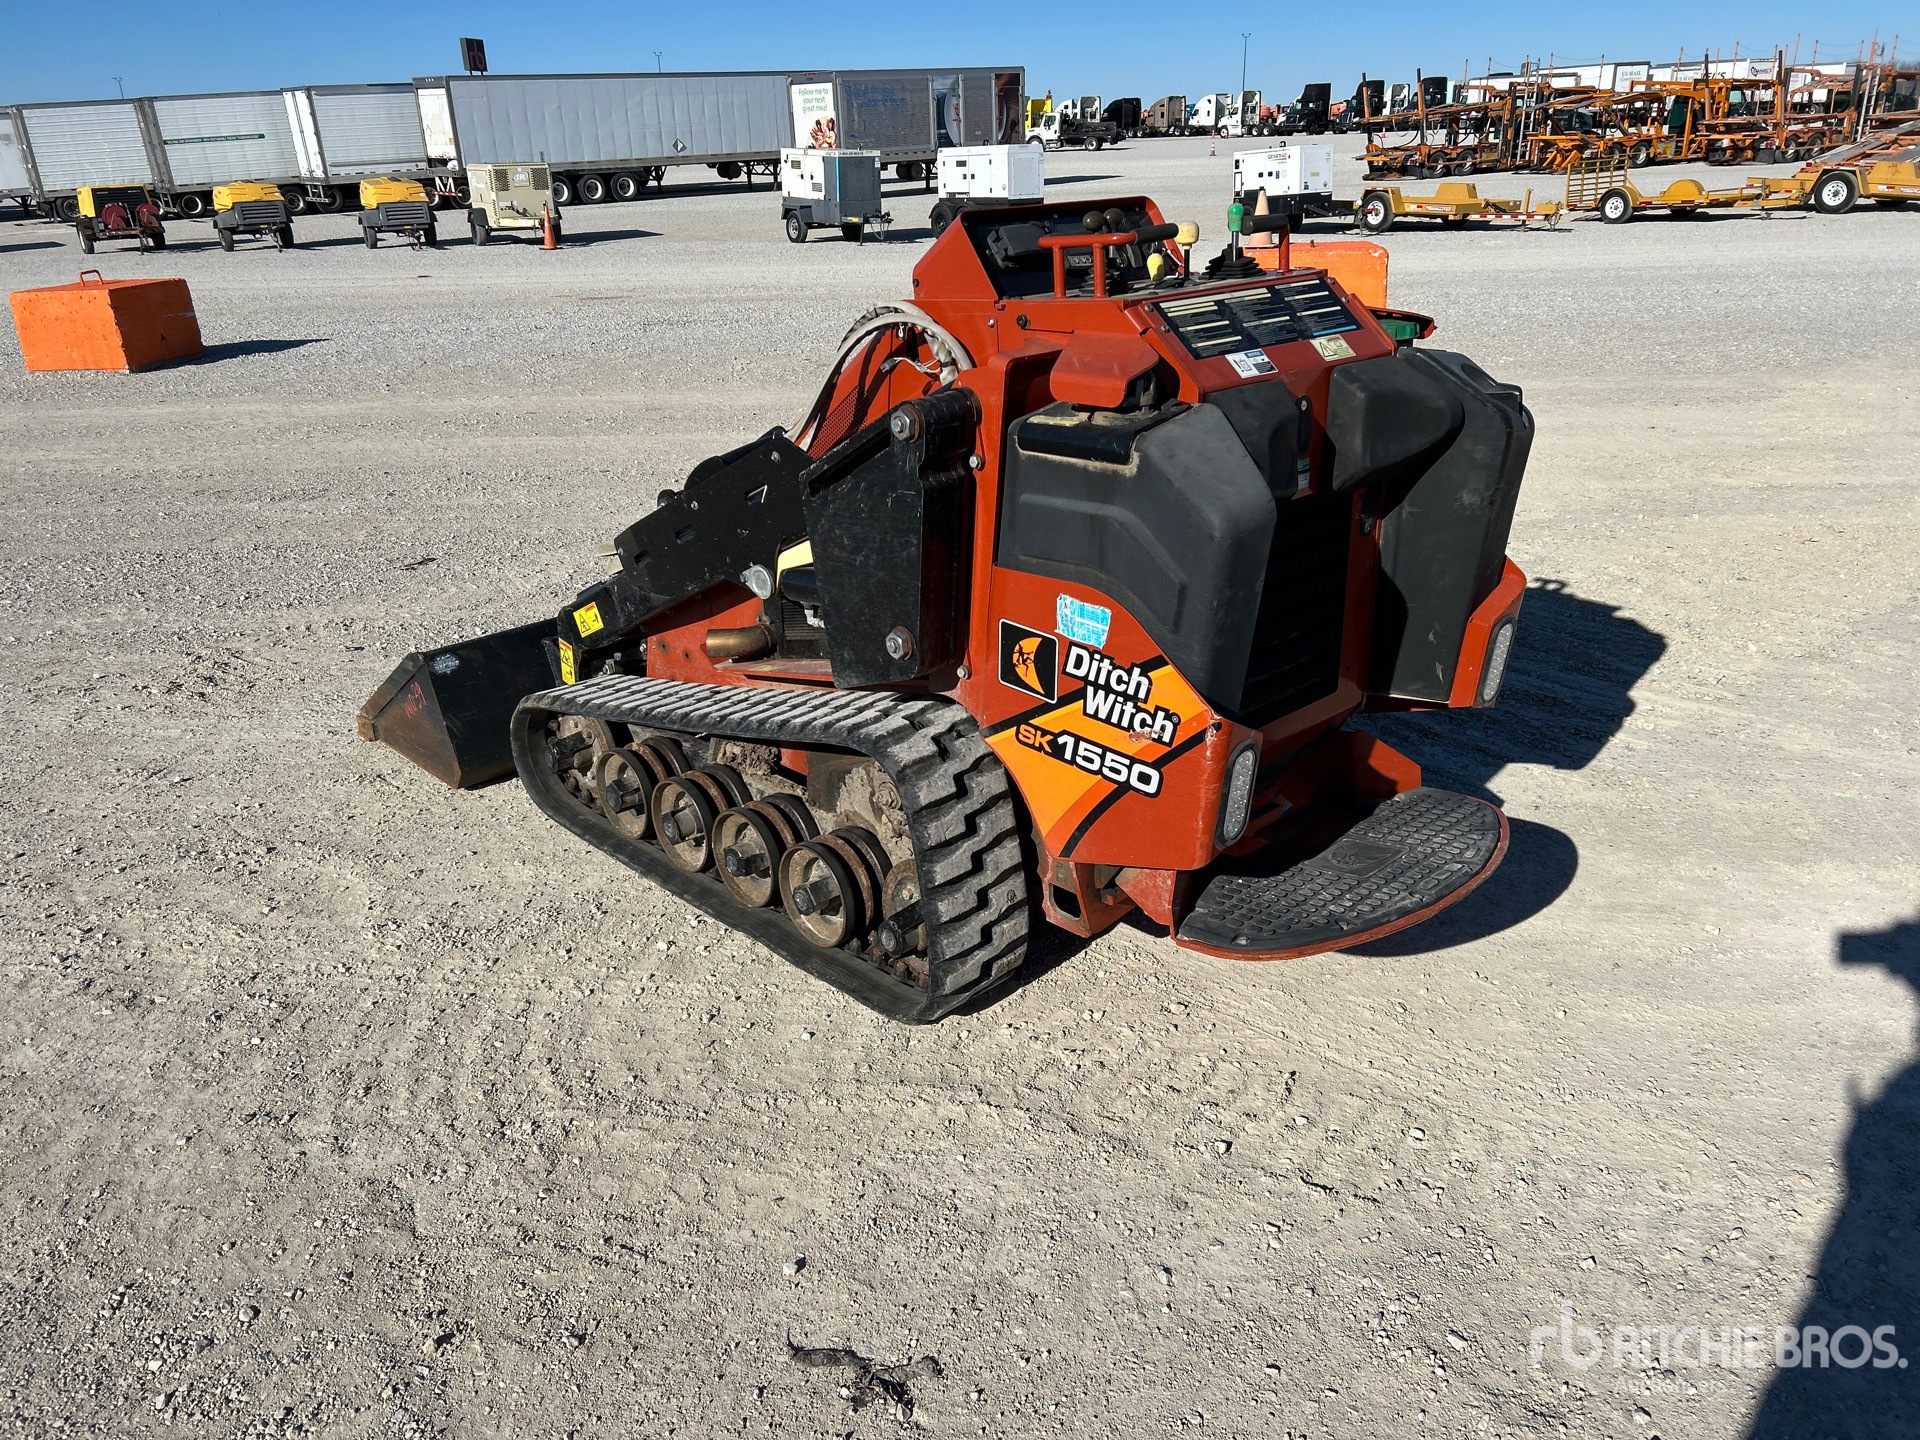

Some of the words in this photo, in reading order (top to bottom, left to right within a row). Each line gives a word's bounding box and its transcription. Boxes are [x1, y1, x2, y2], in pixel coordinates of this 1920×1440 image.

[798, 88, 814, 96] Follow
[802, 105, 814, 113] great
[1065, 645, 1150, 701] Ditch
[1086, 686, 1177, 744] Witch
[1018, 725, 1161, 795] SK1550
